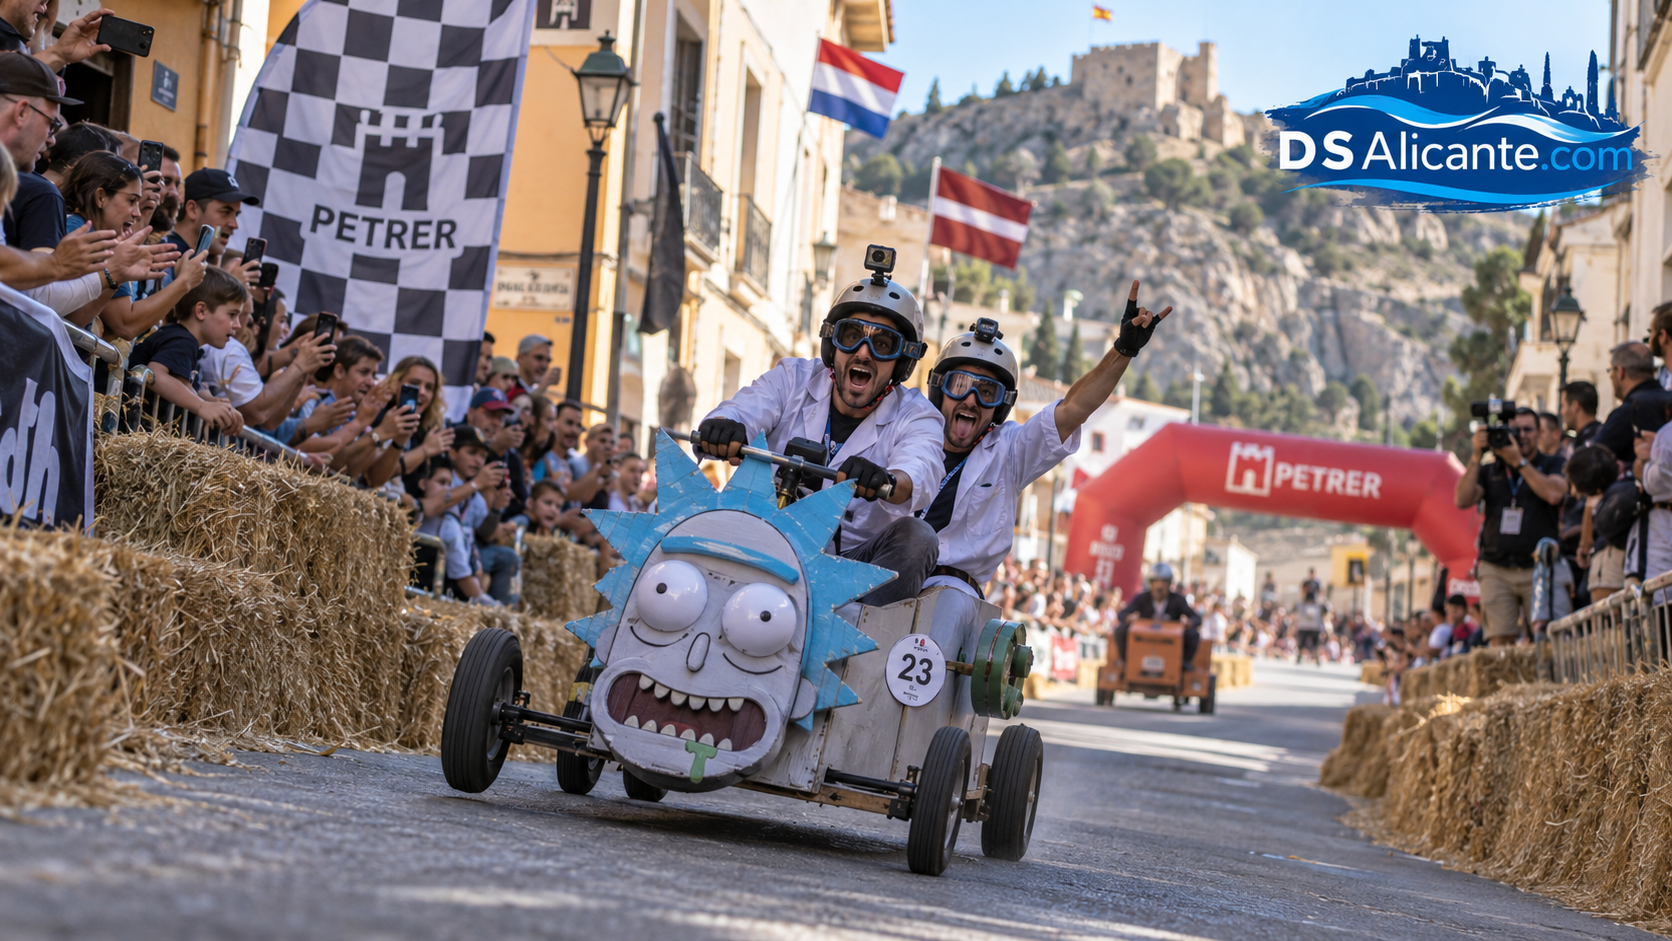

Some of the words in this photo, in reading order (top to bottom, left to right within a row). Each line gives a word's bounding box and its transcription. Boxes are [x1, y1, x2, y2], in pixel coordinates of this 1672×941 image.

[310, 203, 457, 250] PETRER
[1274, 461, 1382, 500] PETRER
[897, 653, 933, 686] 23
